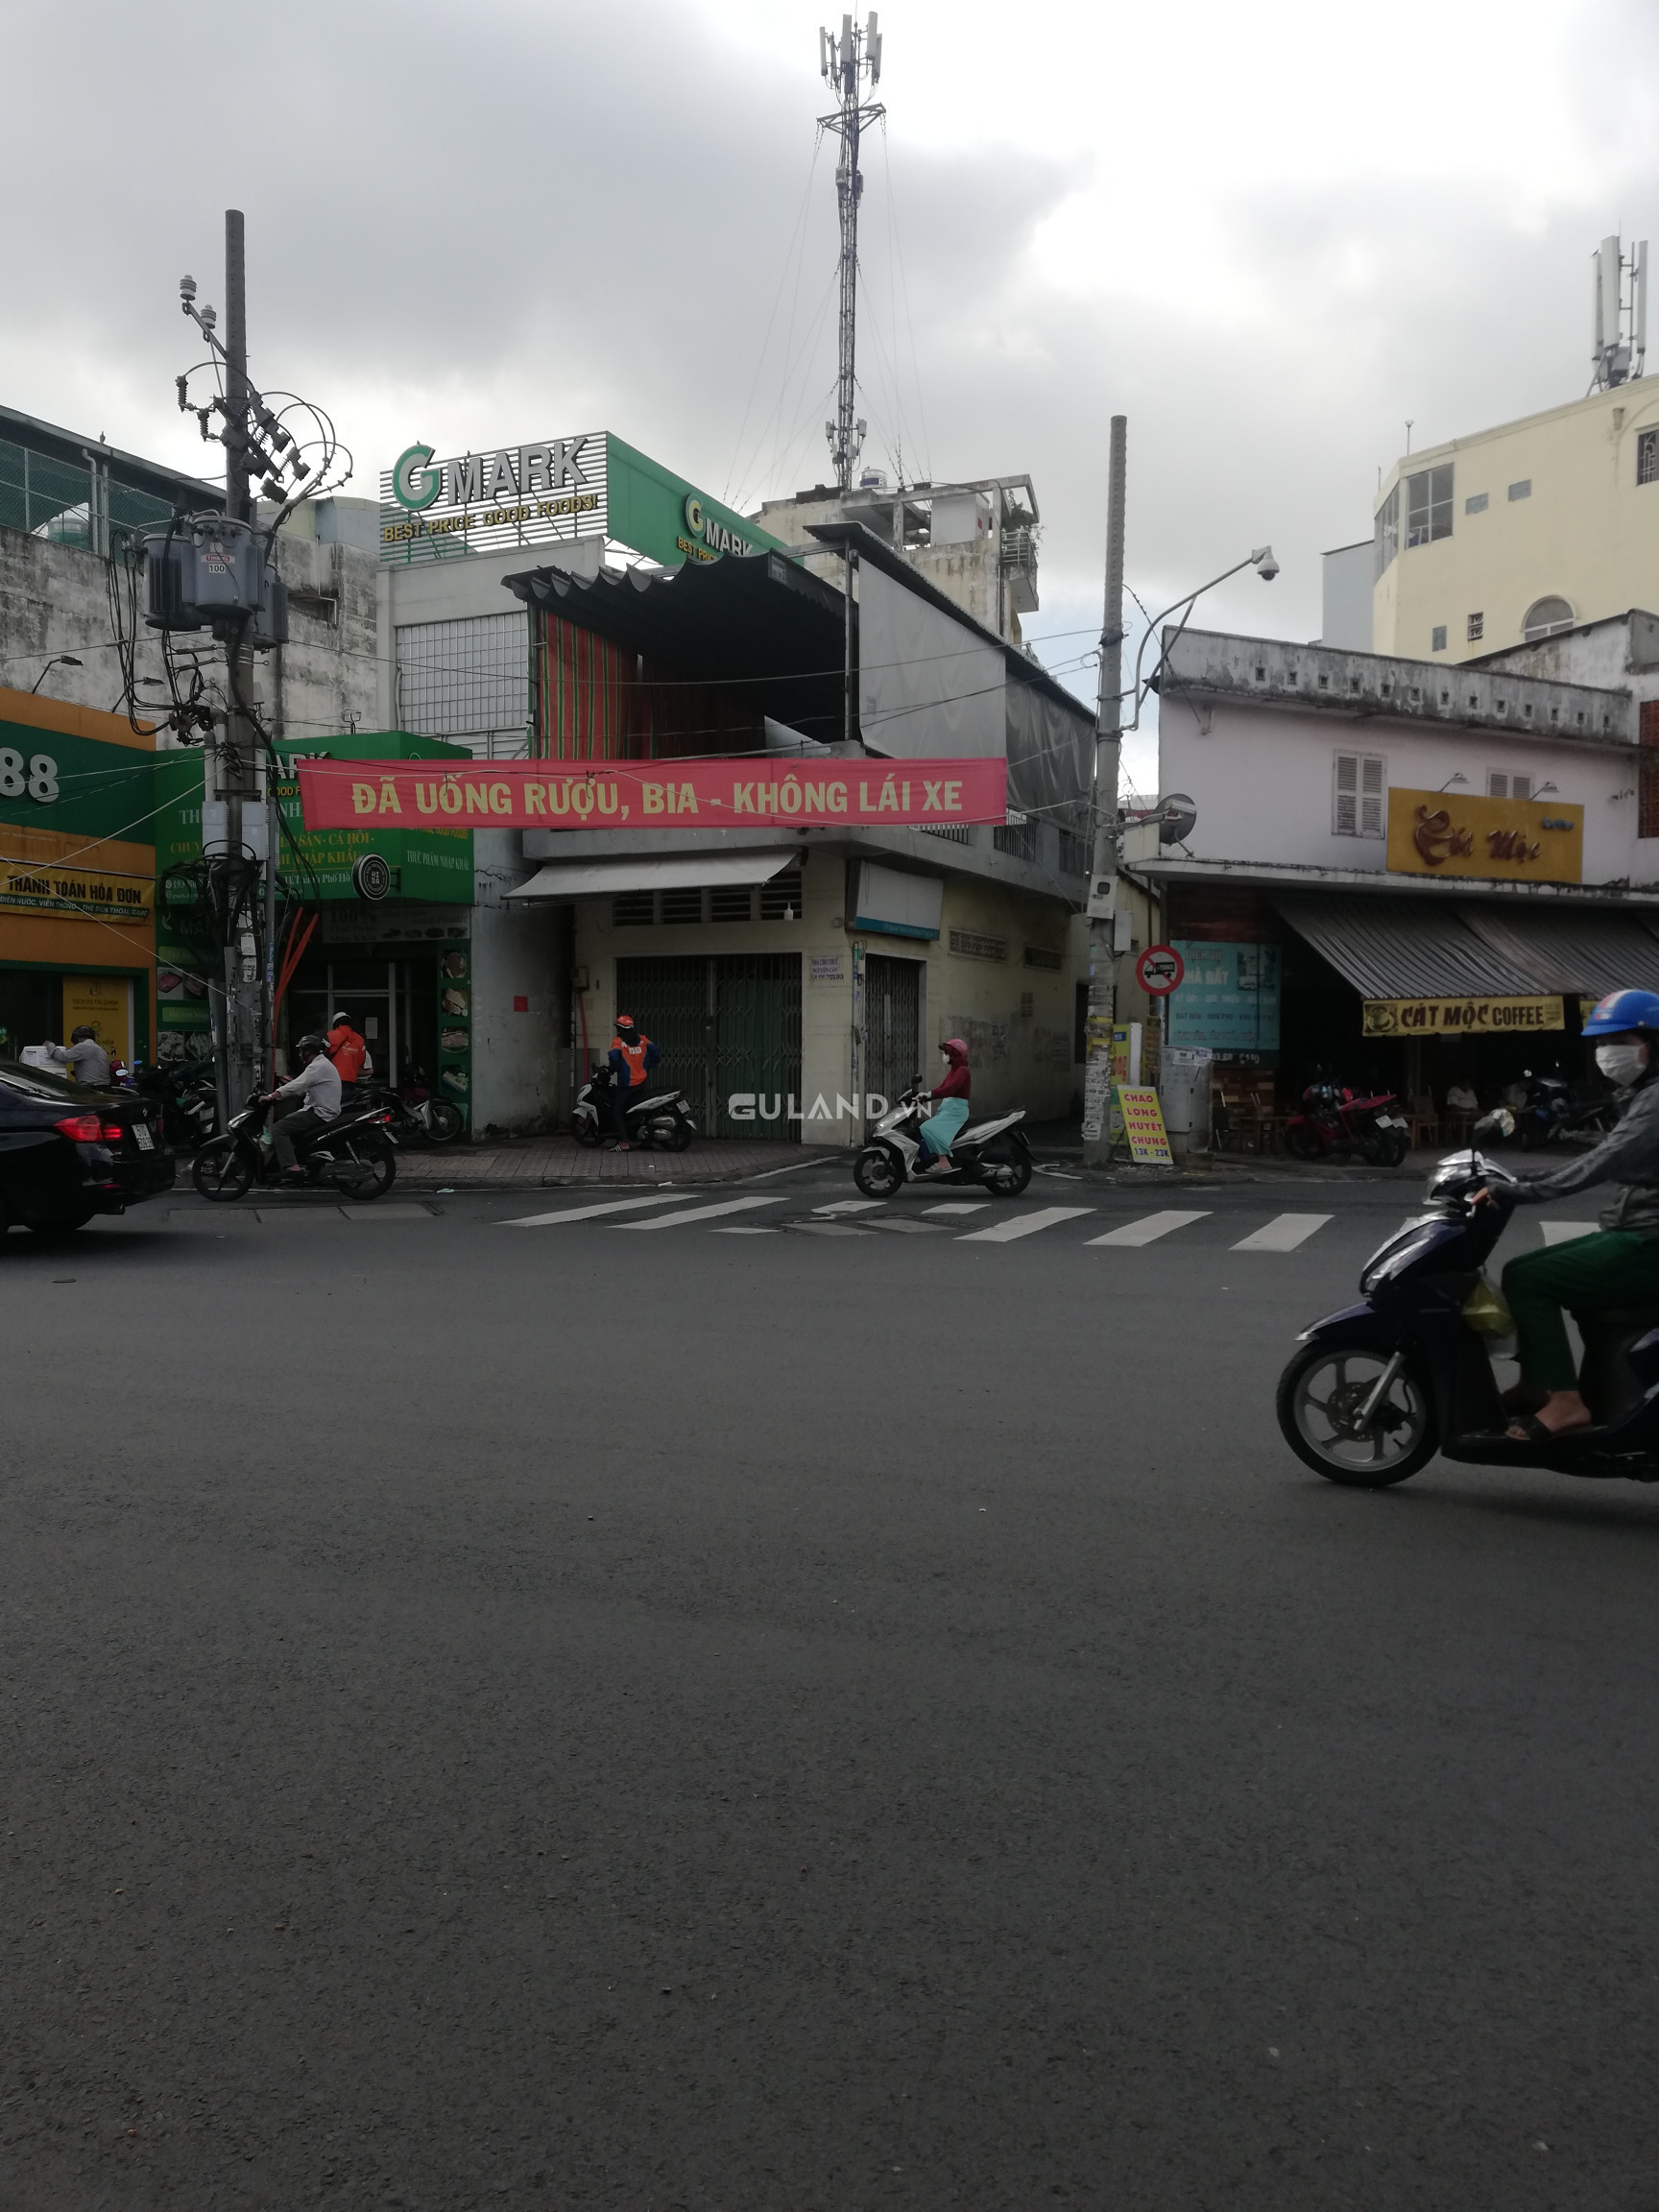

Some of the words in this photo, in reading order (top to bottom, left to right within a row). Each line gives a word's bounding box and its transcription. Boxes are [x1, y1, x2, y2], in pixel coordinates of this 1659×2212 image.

[384, 522, 422, 542] BEST
[429, 515, 476, 535] PRICE
[483, 505, 531, 526] GOOD
[537, 493, 599, 518] FOODS!
[678, 536, 696, 556] BEST
[351, 776, 403, 814] ĐÃ
[415, 773, 513, 815] UỐNG
[523, 778, 630, 821] RƯỢU,
[641, 782, 700, 814] BIA
[733, 774, 849, 814] KHÔNG
[859, 773, 911, 812] LÁI
[922, 781, 963, 812] XE
[1401, 1002, 1439, 1027] CÁT
[1443, 1000, 1490, 1029] MỘC
[1492, 1005, 1545, 1026] COFFEE
